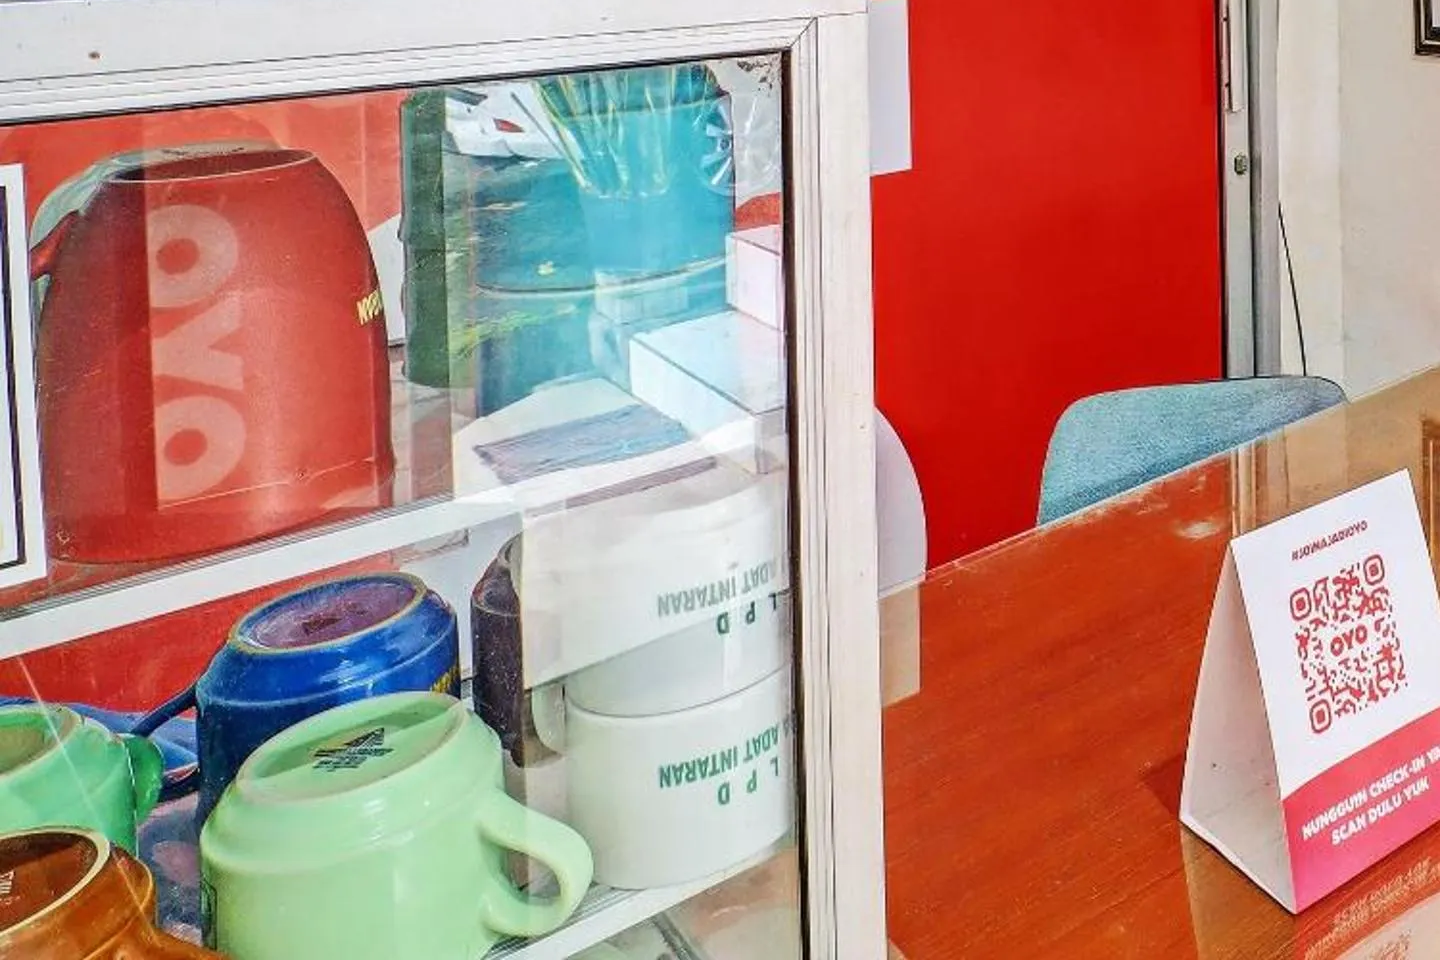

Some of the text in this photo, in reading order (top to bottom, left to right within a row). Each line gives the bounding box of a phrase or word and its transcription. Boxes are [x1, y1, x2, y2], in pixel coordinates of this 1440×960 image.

[657, 576, 736, 618] INTARAN
[1330, 624, 1368, 656] OYO
[658, 722, 779, 789] ADAT INTARAN
[1301, 787, 1368, 840] NUNGGUIN
[1368, 755, 1426, 798] CHECK-IN
[1331, 776, 1430, 846] SCAN DULU YUK
